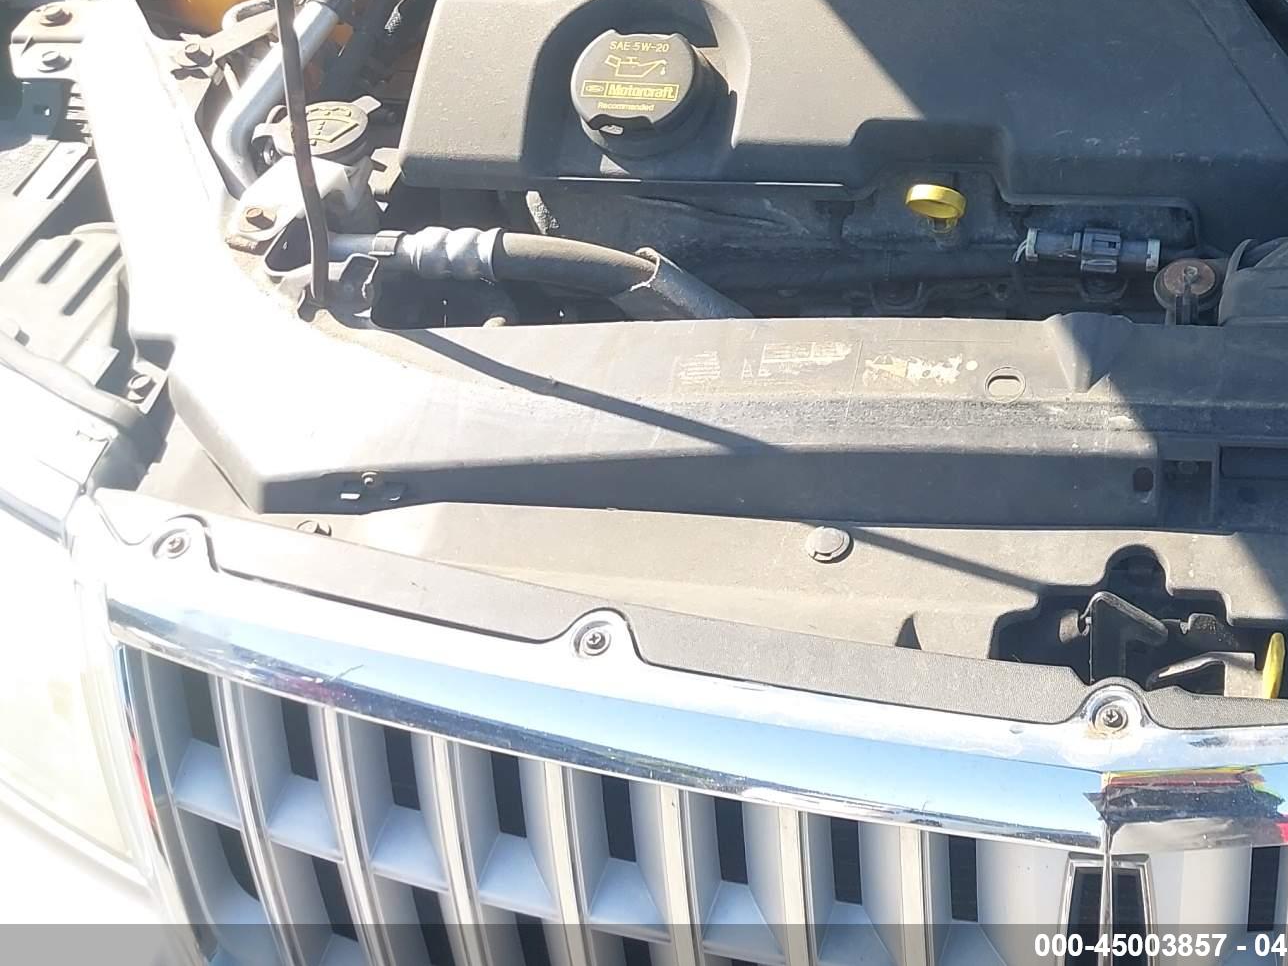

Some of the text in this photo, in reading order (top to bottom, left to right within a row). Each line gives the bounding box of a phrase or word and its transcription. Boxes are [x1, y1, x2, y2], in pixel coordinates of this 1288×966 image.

[609, 41, 670, 52] SAE 5W-20
[598, 102, 655, 111] Recommended
